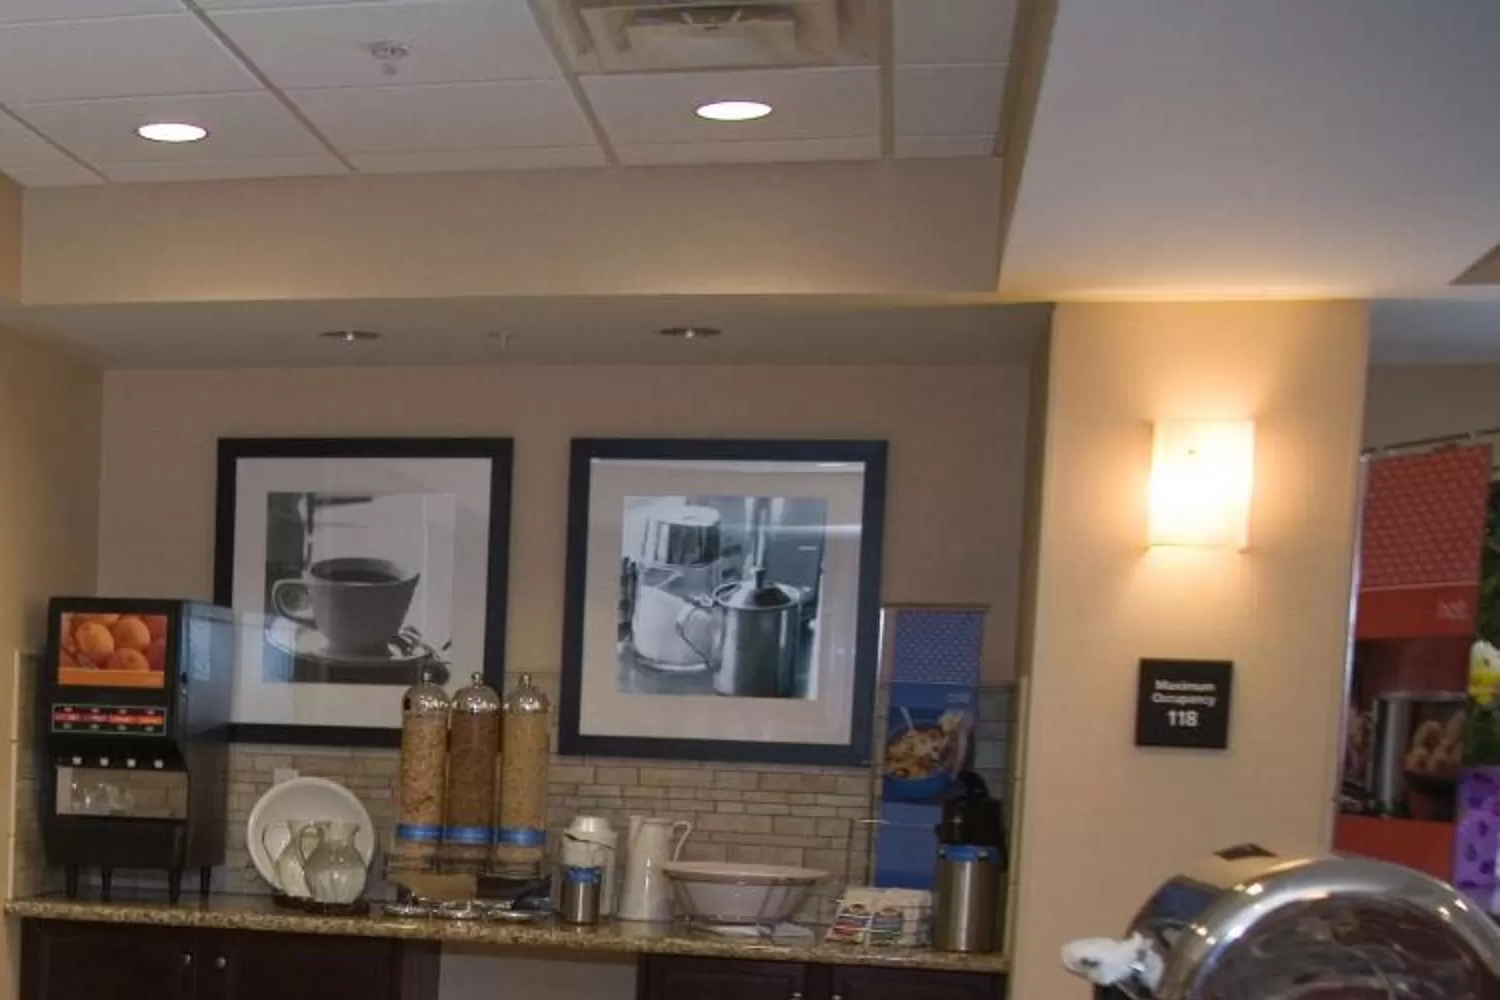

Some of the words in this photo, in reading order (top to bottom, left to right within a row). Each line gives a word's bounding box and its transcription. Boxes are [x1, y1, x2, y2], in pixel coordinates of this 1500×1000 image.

[1155, 679, 1216, 691] Maximum
[1151, 692, 1216, 707] Occupancy
[1167, 710, 1198, 726] 118
